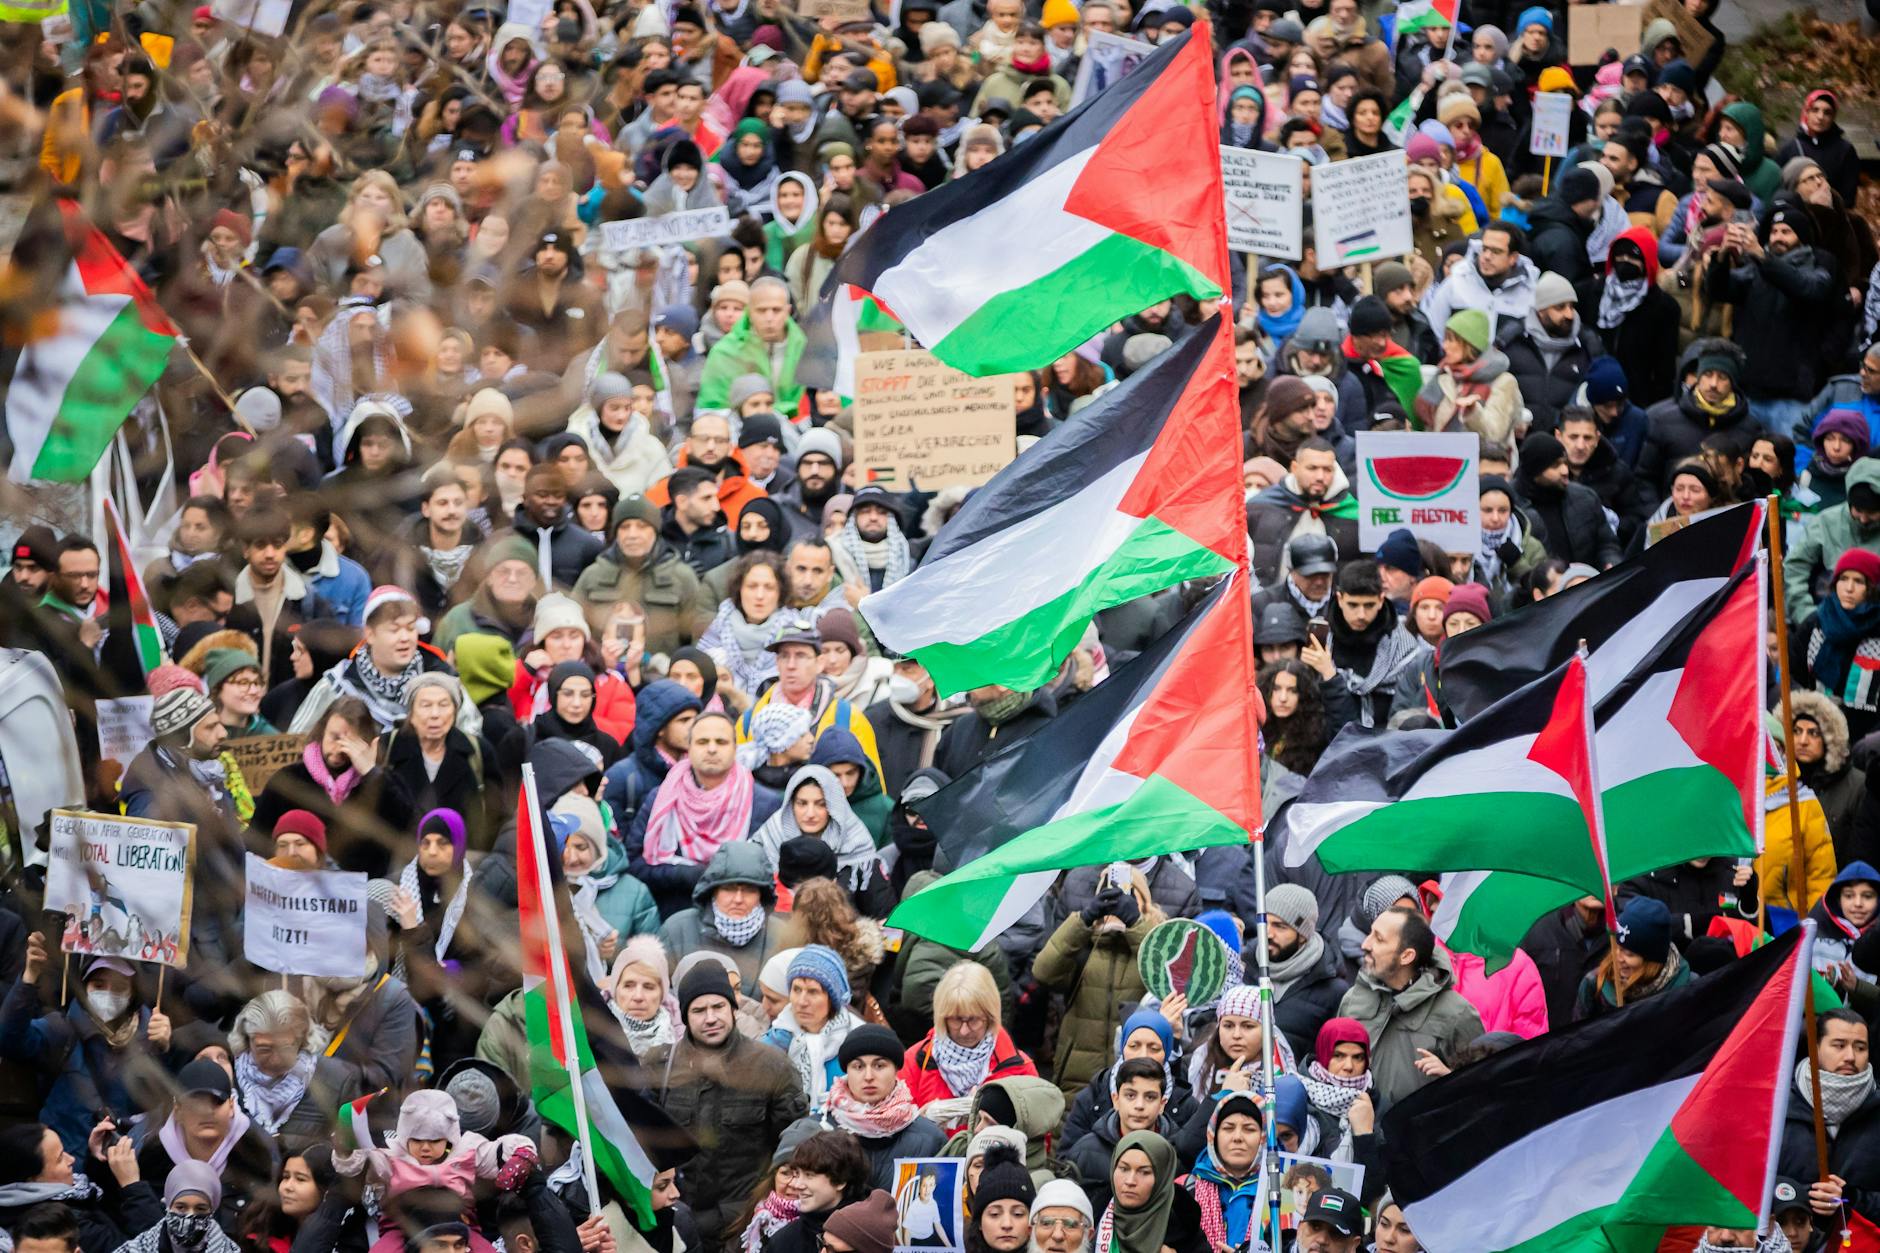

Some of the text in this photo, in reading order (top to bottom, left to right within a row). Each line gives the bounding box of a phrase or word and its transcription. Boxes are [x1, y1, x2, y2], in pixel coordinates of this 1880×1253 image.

[859, 375, 911, 394] STOPPT
[1372, 508, 1469, 527] FREE PALESTINE
[55, 818, 98, 837] GENERATION
[128, 826, 173, 842] GENERATION
[80, 842, 110, 864] TOTAL
[272, 924, 309, 945] JETZT!
